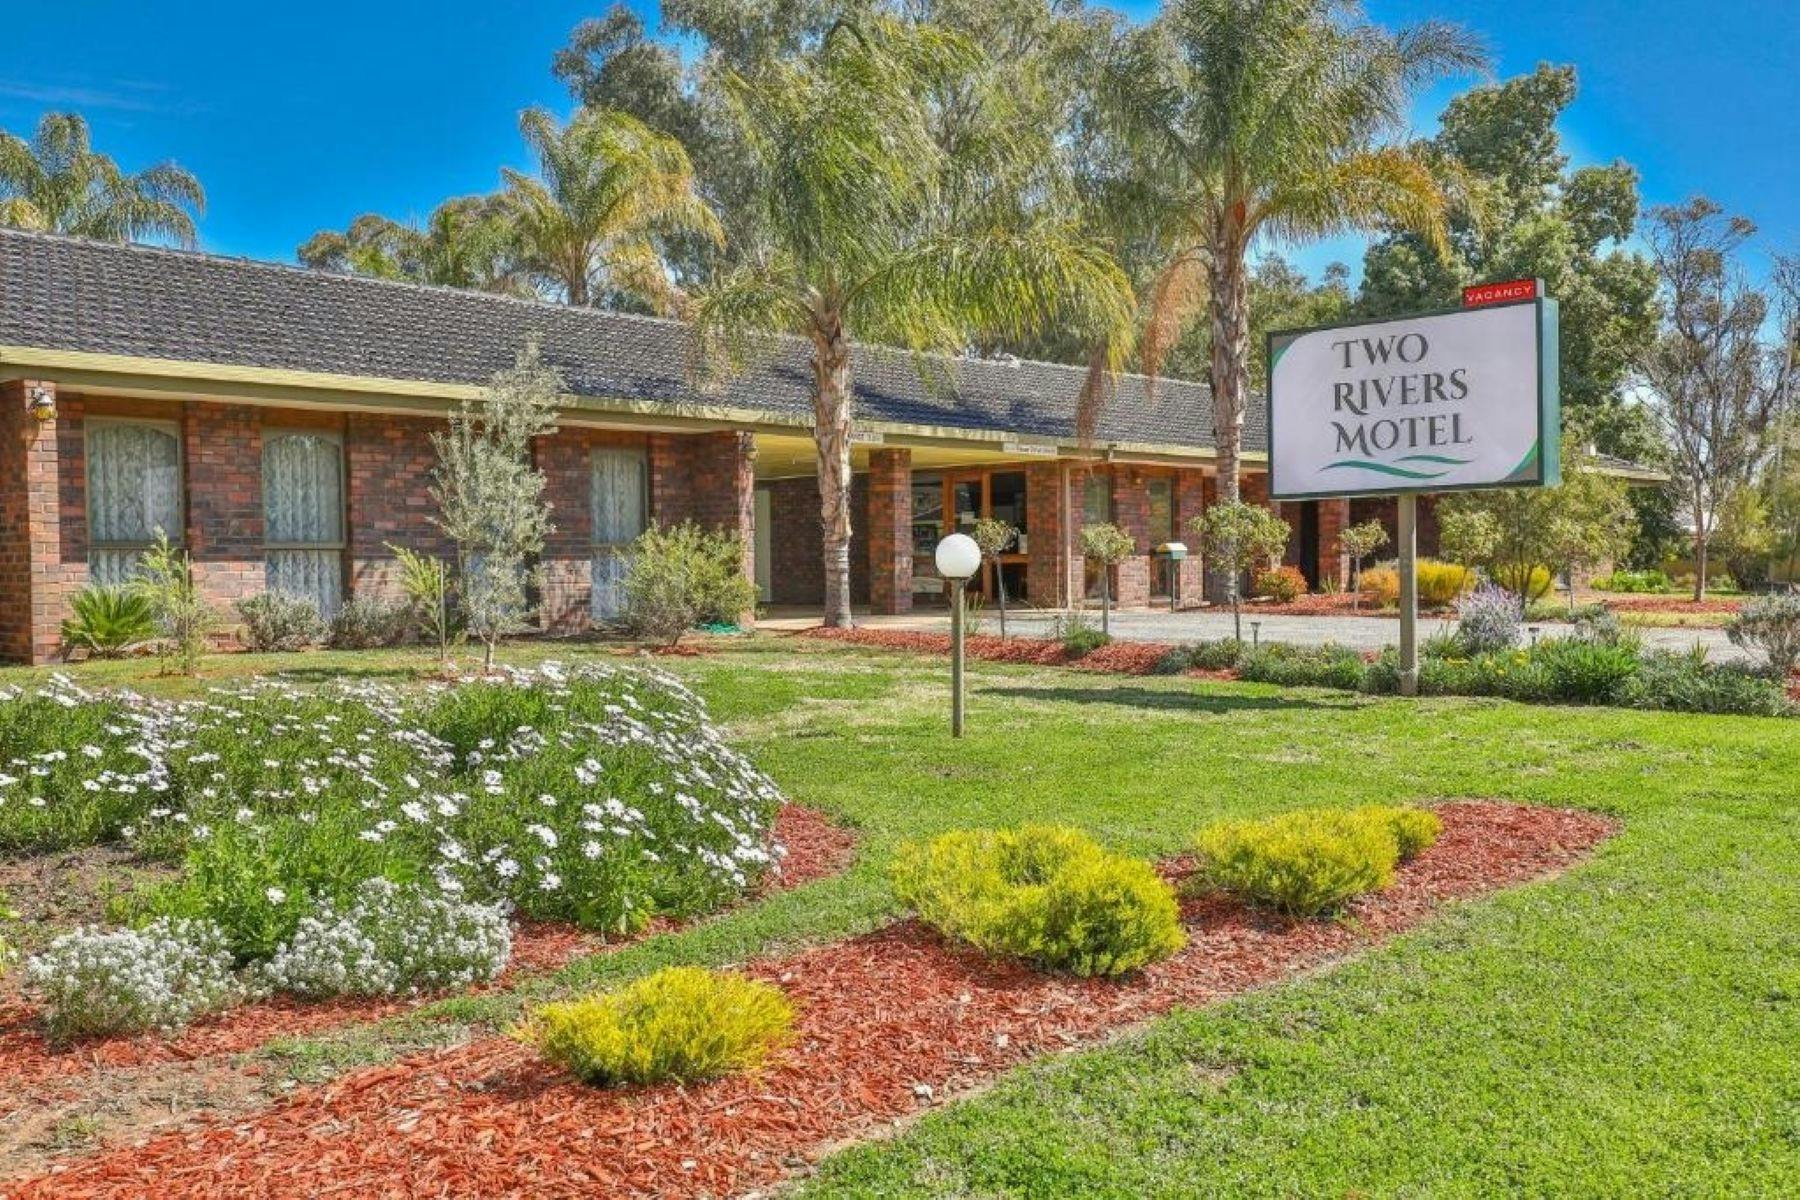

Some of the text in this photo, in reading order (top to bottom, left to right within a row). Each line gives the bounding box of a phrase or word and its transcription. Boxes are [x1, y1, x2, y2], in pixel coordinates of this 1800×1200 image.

[1466, 285, 1532, 301] VACANCY
[1332, 333, 1429, 368] TWO
[1333, 368, 1468, 415] RIVERS
[1330, 413, 1473, 456] MOTEL
